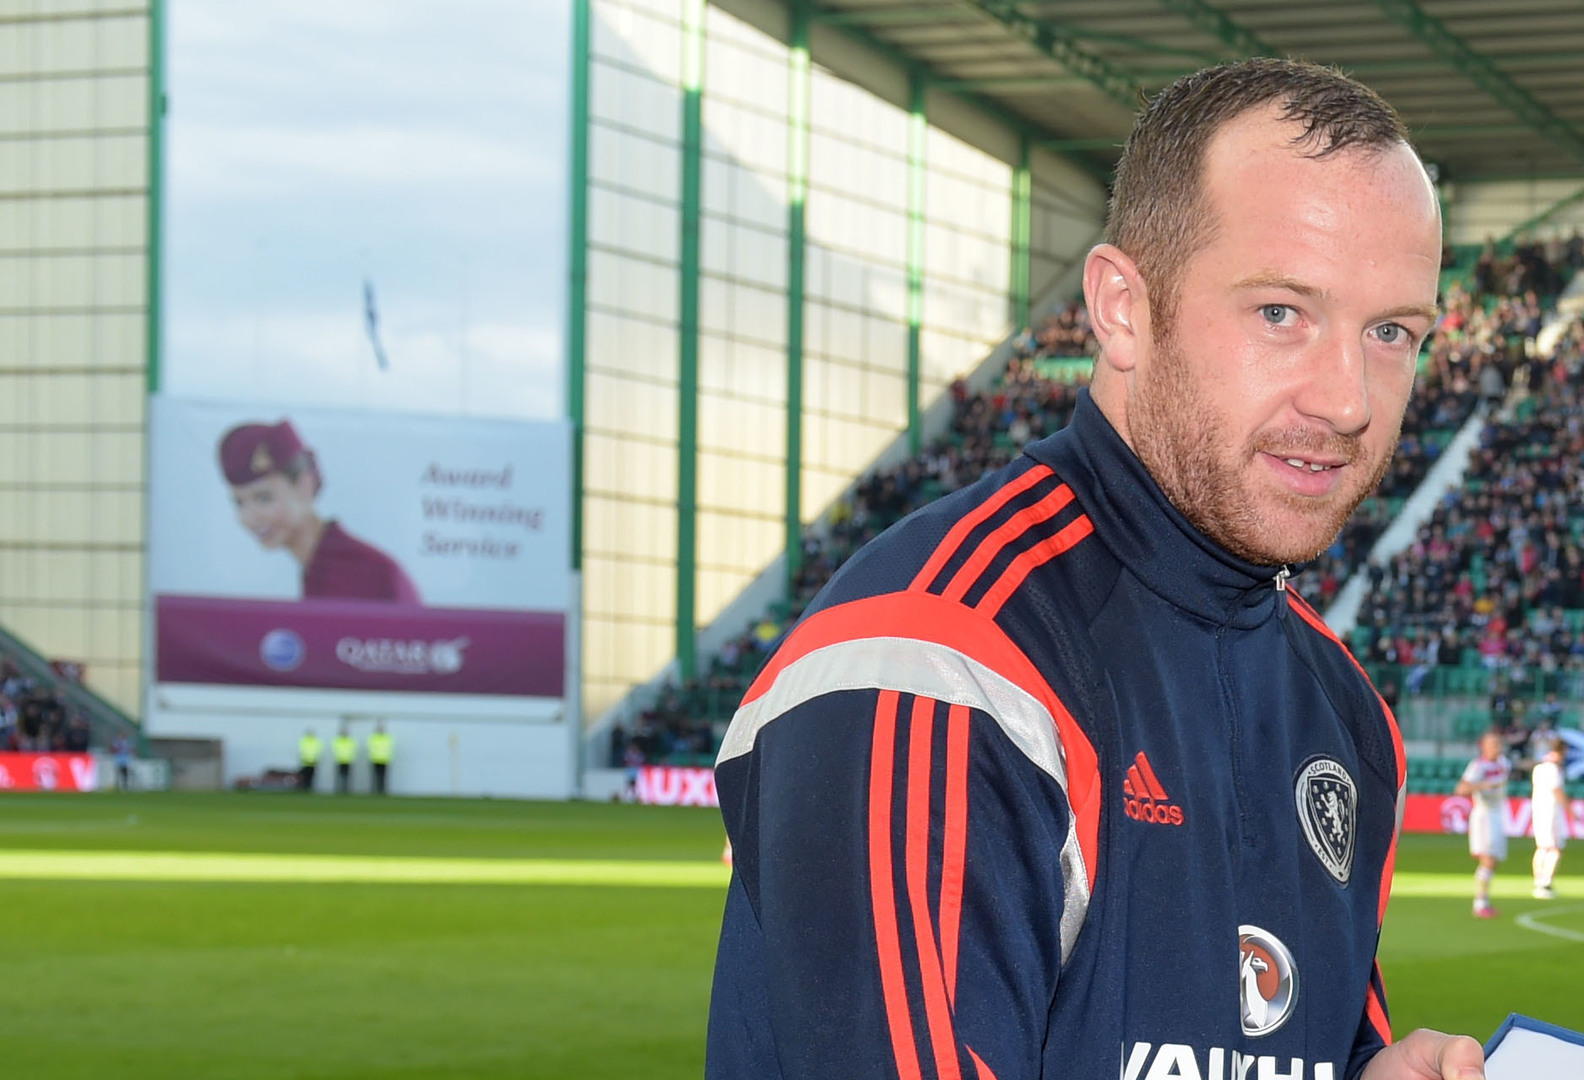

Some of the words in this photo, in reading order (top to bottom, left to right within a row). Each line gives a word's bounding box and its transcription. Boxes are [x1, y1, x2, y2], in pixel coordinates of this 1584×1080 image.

[420, 461, 514, 489] Award
[421, 496, 544, 531] Winning
[418, 530, 521, 557] Service
[336, 636, 428, 664] QATAR
[1310, 762, 1347, 780] SCOTLAND
